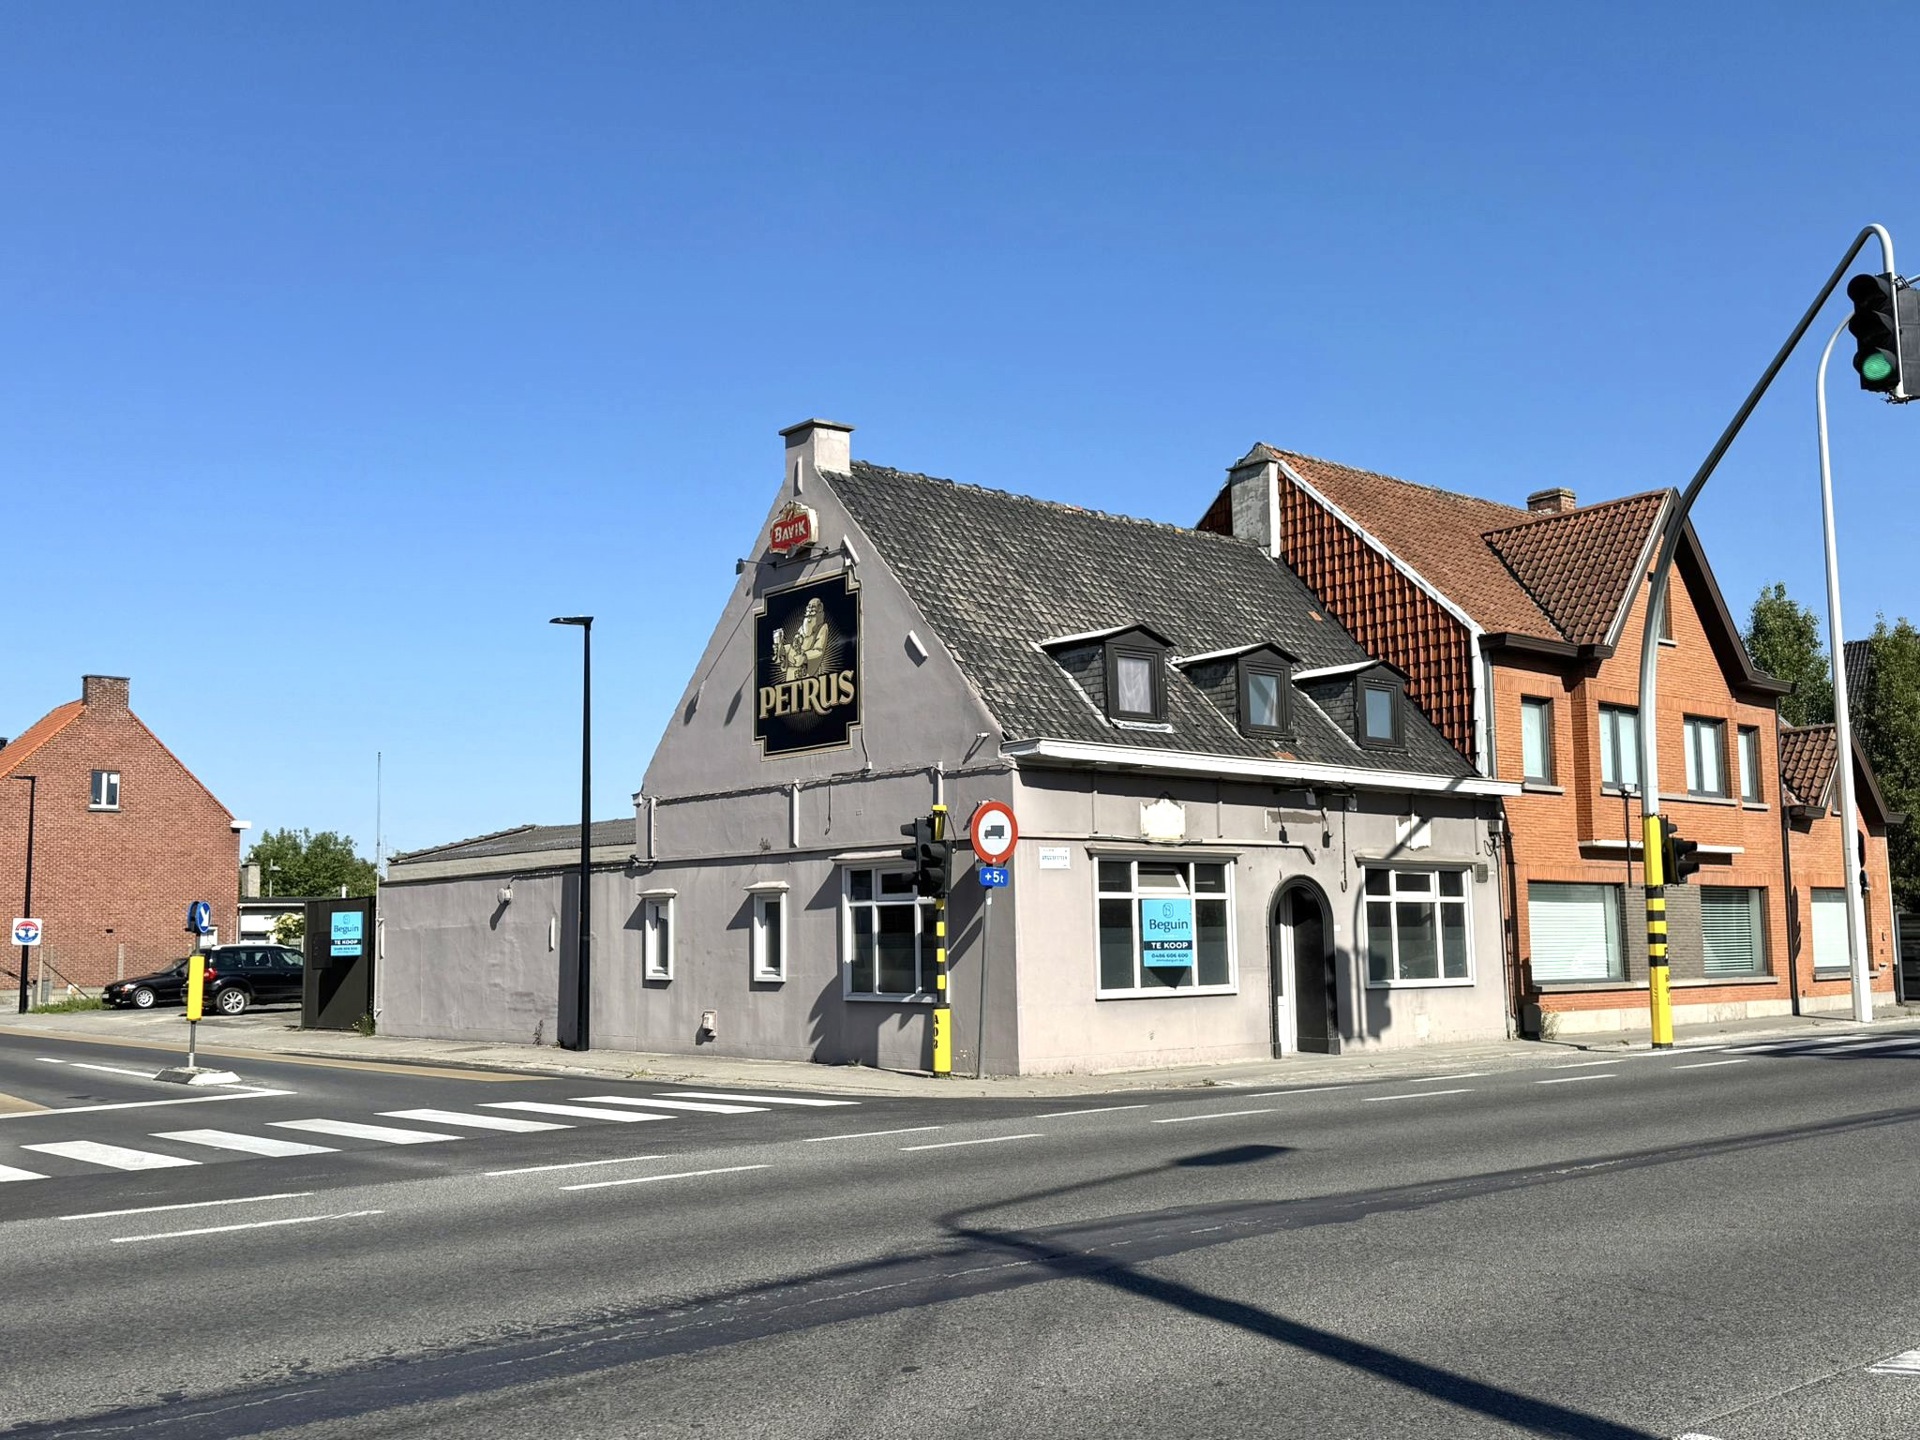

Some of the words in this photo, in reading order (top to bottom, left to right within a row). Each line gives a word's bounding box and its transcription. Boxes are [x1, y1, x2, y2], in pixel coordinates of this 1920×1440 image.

[774, 519, 807, 542] BAVIK
[759, 669, 855, 719] PETRUS
[334, 924, 359, 935] Beguin
[1149, 919, 1189, 933] Beguin
